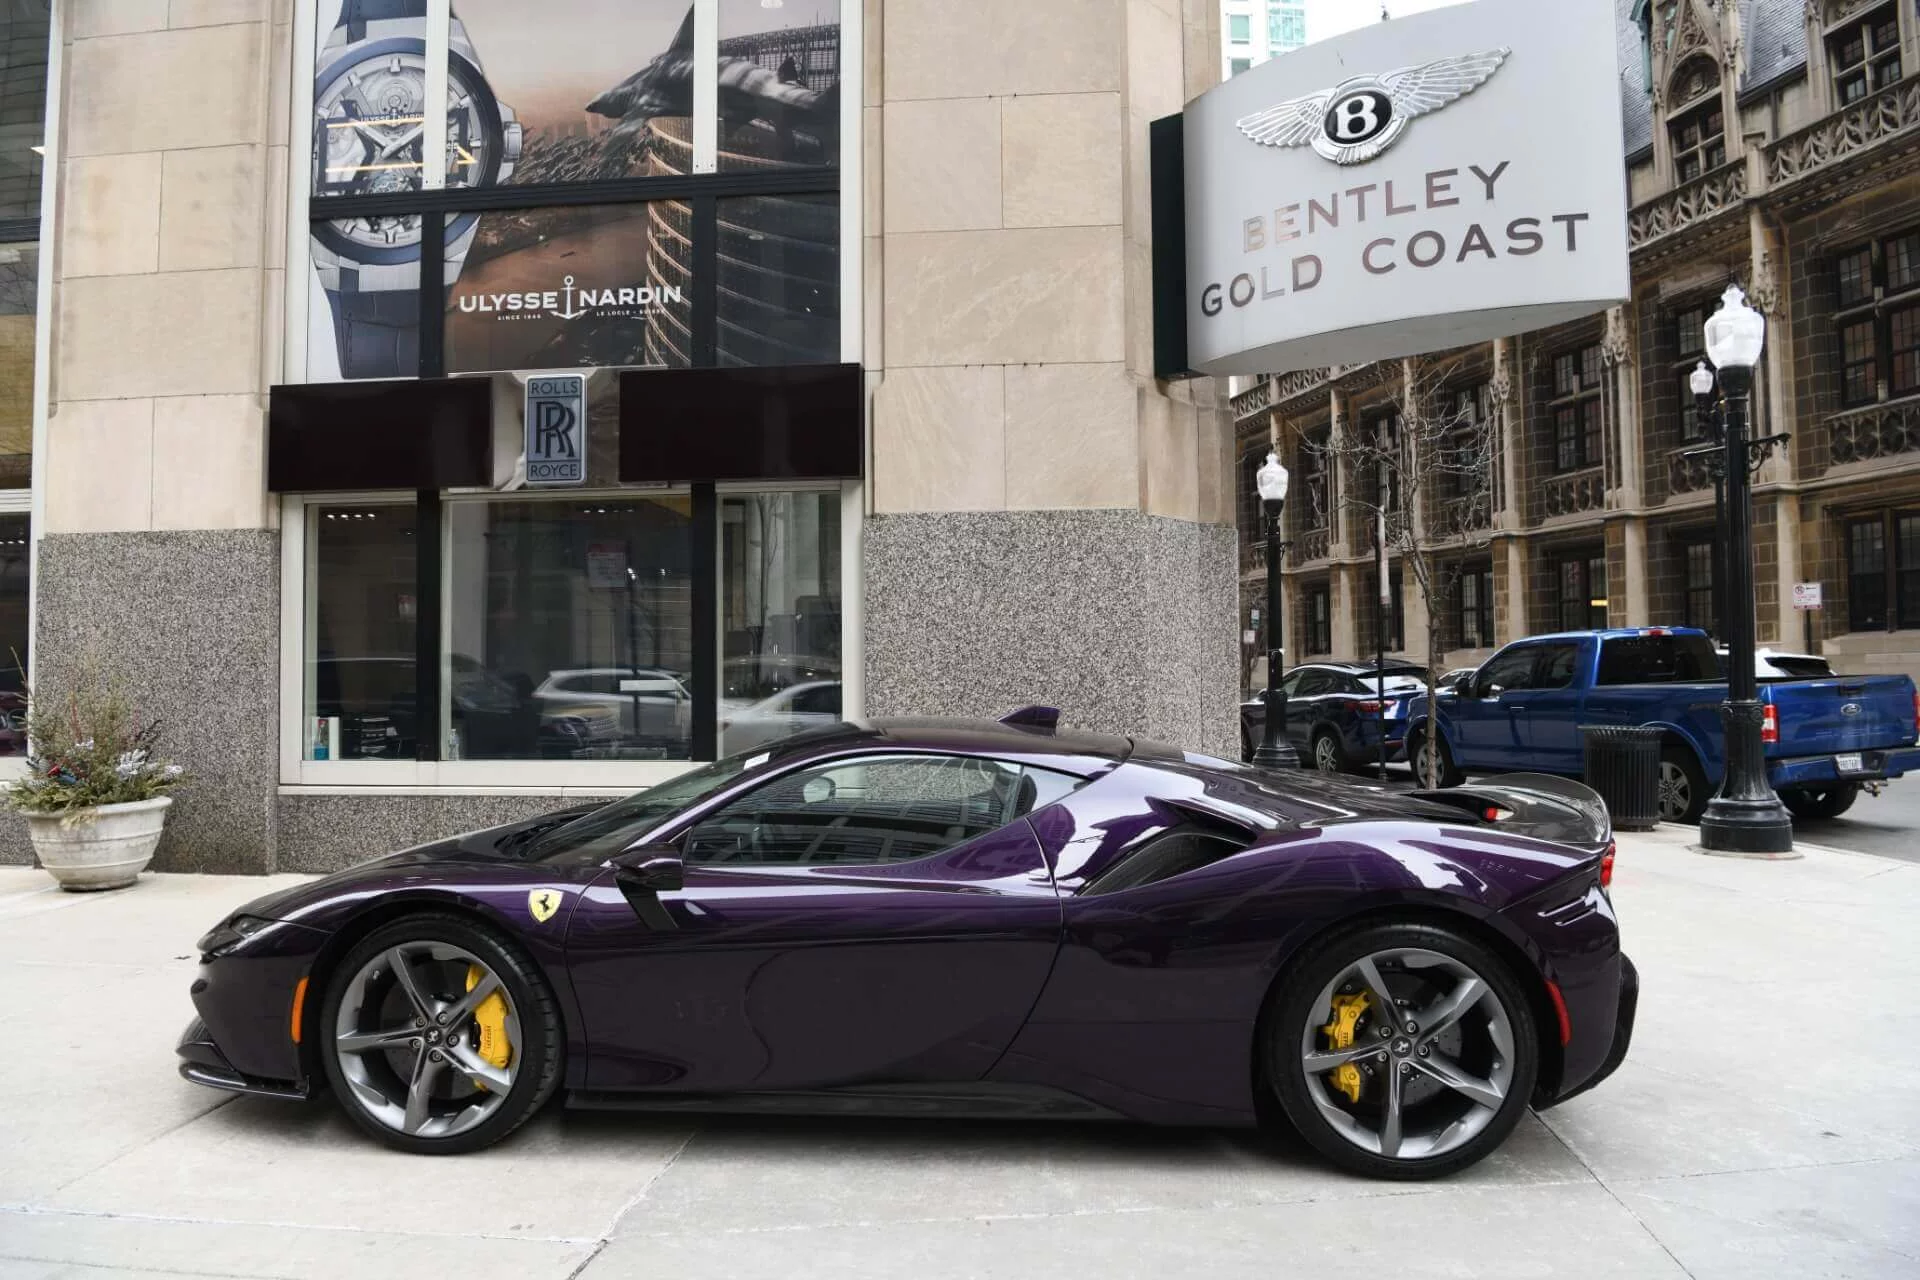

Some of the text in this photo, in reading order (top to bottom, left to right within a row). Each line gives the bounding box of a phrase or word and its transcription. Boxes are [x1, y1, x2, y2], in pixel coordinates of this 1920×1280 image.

[1243, 160, 1511, 254] BENTLEY
[1200, 212, 1590, 317] GOLD COAST
[460, 286, 681, 312] ULYSSE NARDIN
[531, 381, 578, 395] ROLLS
[530, 463, 578, 477] ROYCE
